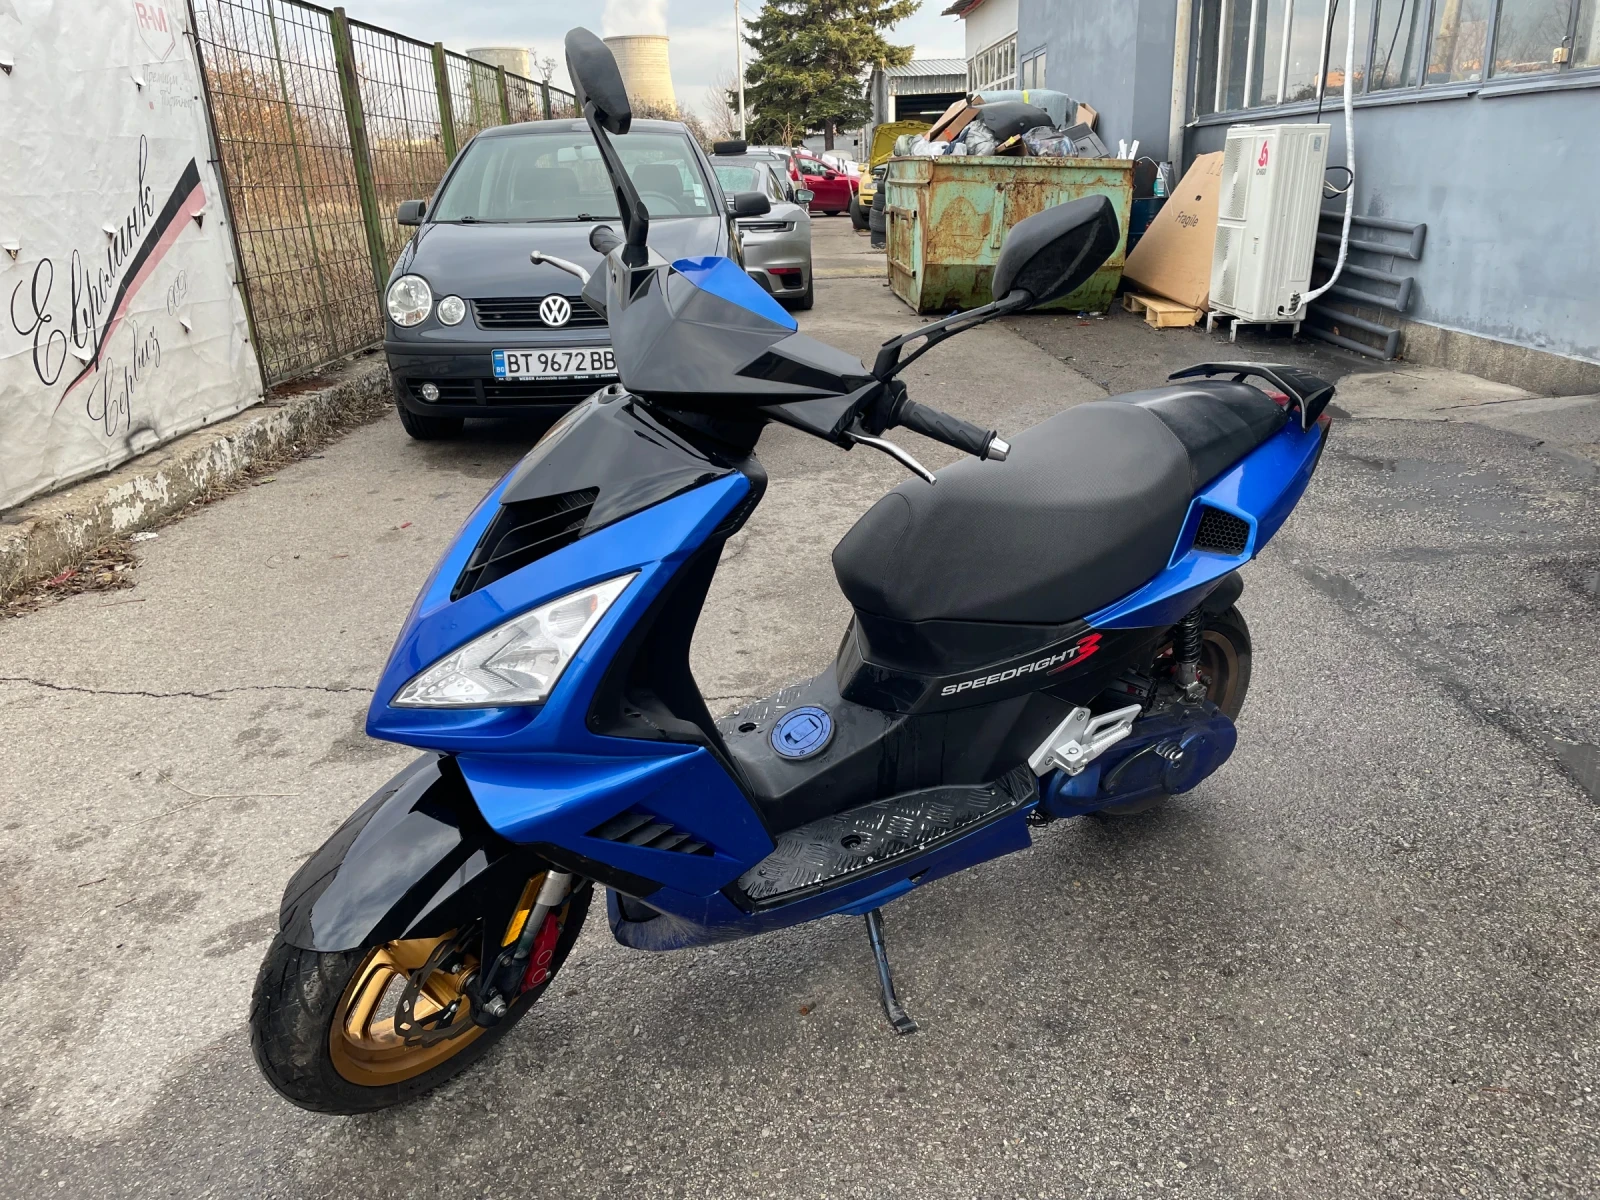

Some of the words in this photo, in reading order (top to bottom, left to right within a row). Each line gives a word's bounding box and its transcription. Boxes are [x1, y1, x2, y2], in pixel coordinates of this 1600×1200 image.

[135, 2, 168, 33] R-M
[1175, 211, 1199, 228] Fragile
[507, 354, 533, 373] BT
[537, 352, 587, 372] 9672
[590, 351, 617, 371] BB
[86, 319, 161, 436] Сервиз
